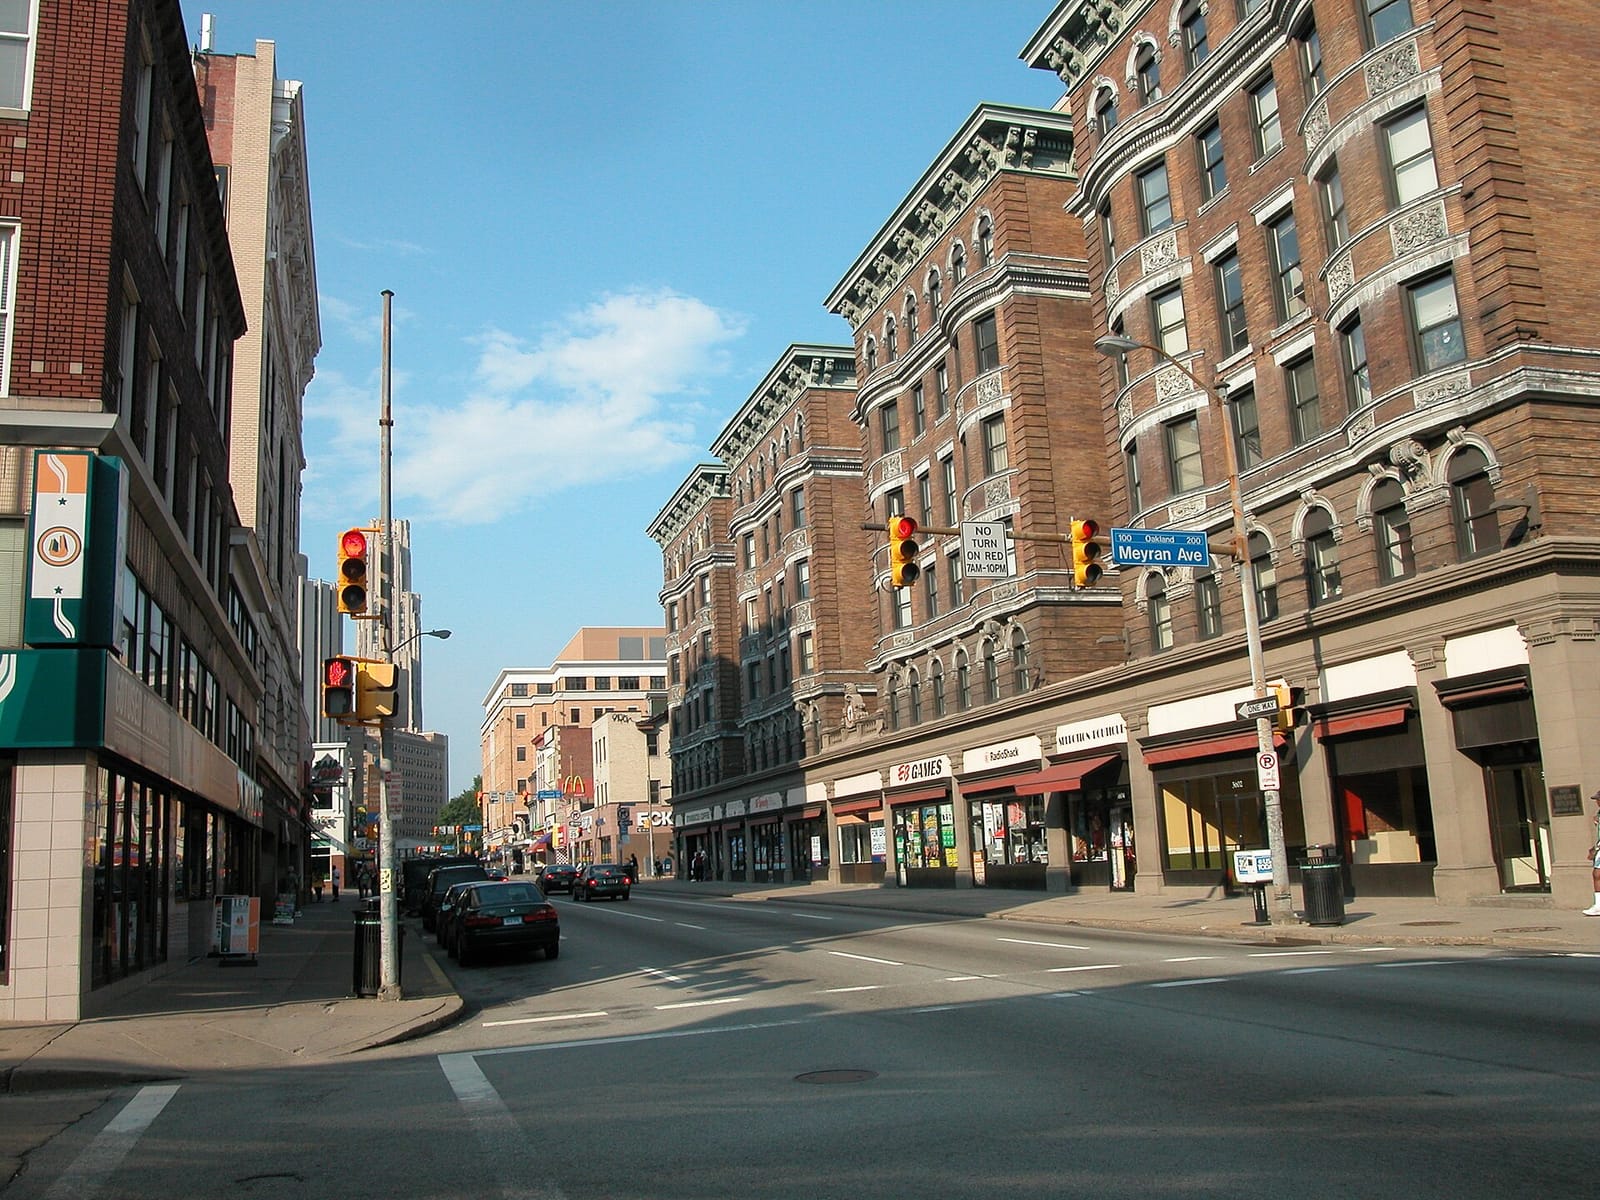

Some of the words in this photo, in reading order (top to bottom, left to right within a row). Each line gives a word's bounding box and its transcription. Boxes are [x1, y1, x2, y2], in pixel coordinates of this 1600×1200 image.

[975, 526, 992, 536] NO
[972, 539, 997, 548] TURN
[1118, 534, 1132, 542] 100
[1145, 535, 1175, 544] Oakland
[1186, 536, 1201, 545] 200
[967, 551, 980, 560] ON
[985, 551, 1004, 561] RED
[1118, 545, 1172, 563] Meyran
[1177, 547, 1202, 562] Ave
[966, 563, 1007, 573] 7AM-10PM
[1247, 704, 1261, 713] ONE
[1262, 701, 1275, 710] WAY
[897, 764, 910, 782] EB
[911, 759, 943, 780] GAMES
